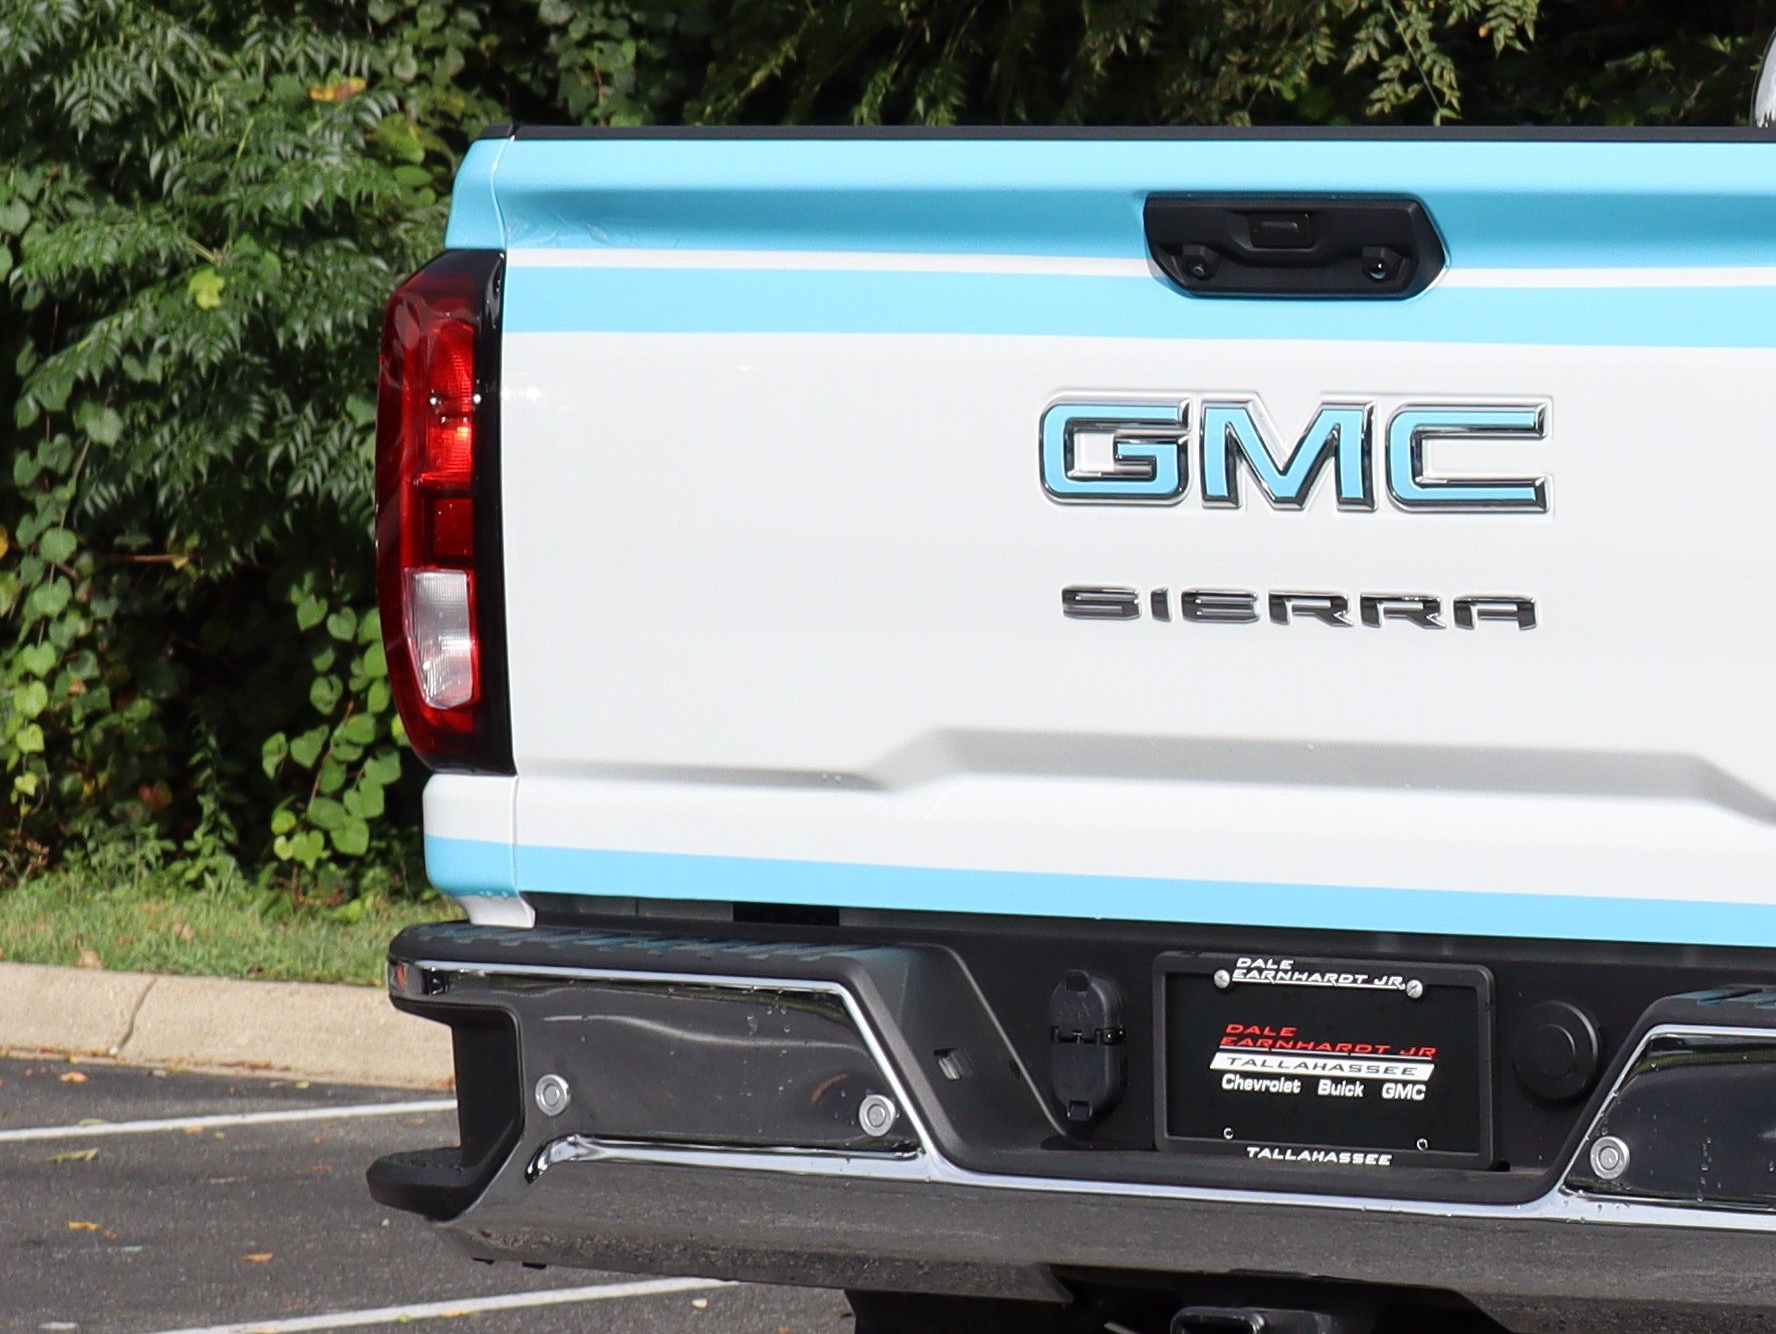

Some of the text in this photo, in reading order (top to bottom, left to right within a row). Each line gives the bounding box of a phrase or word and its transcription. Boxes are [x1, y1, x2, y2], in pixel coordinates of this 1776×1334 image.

[1040, 396, 1551, 514] GMC
[1061, 583, 1542, 631] SIERRA
[1235, 957, 1295, 971] DALE
[1232, 969, 1370, 987] EARNHARDT
[1224, 1023, 1298, 1038] DALE
[1219, 1037, 1439, 1058] EARNHARDT JR
[1226, 1056, 1421, 1077] TALLAHASSEE
[1221, 1073, 1427, 1102] Chevrolet Buick GMC
[1246, 1146, 1394, 1167] TALLAHASSEE
